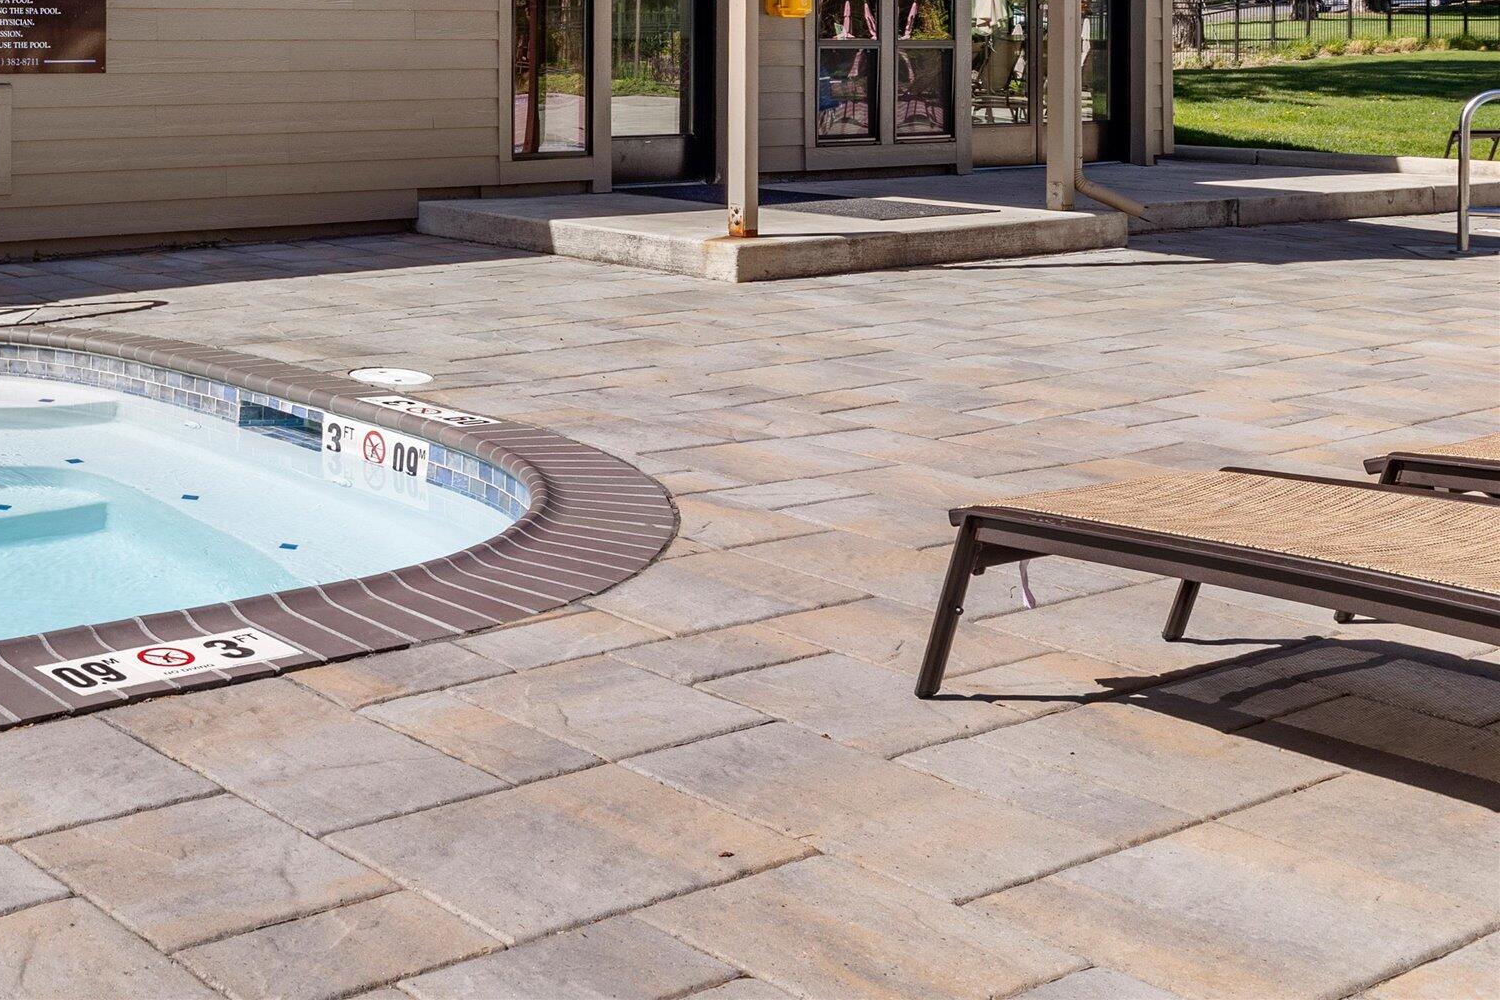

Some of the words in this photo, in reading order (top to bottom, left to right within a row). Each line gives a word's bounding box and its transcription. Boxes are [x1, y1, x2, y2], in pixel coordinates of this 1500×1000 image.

[7, 58, 38, 66] 382-8711
[326, 423, 342, 453] 3
[343, 426, 355, 440] FT
[418, 448, 426, 460] M
[103, 657, 120, 665] M
[203, 639, 255, 659] 3
[233, 633, 259, 643] FT
[181, 663, 215, 673] DIVING
